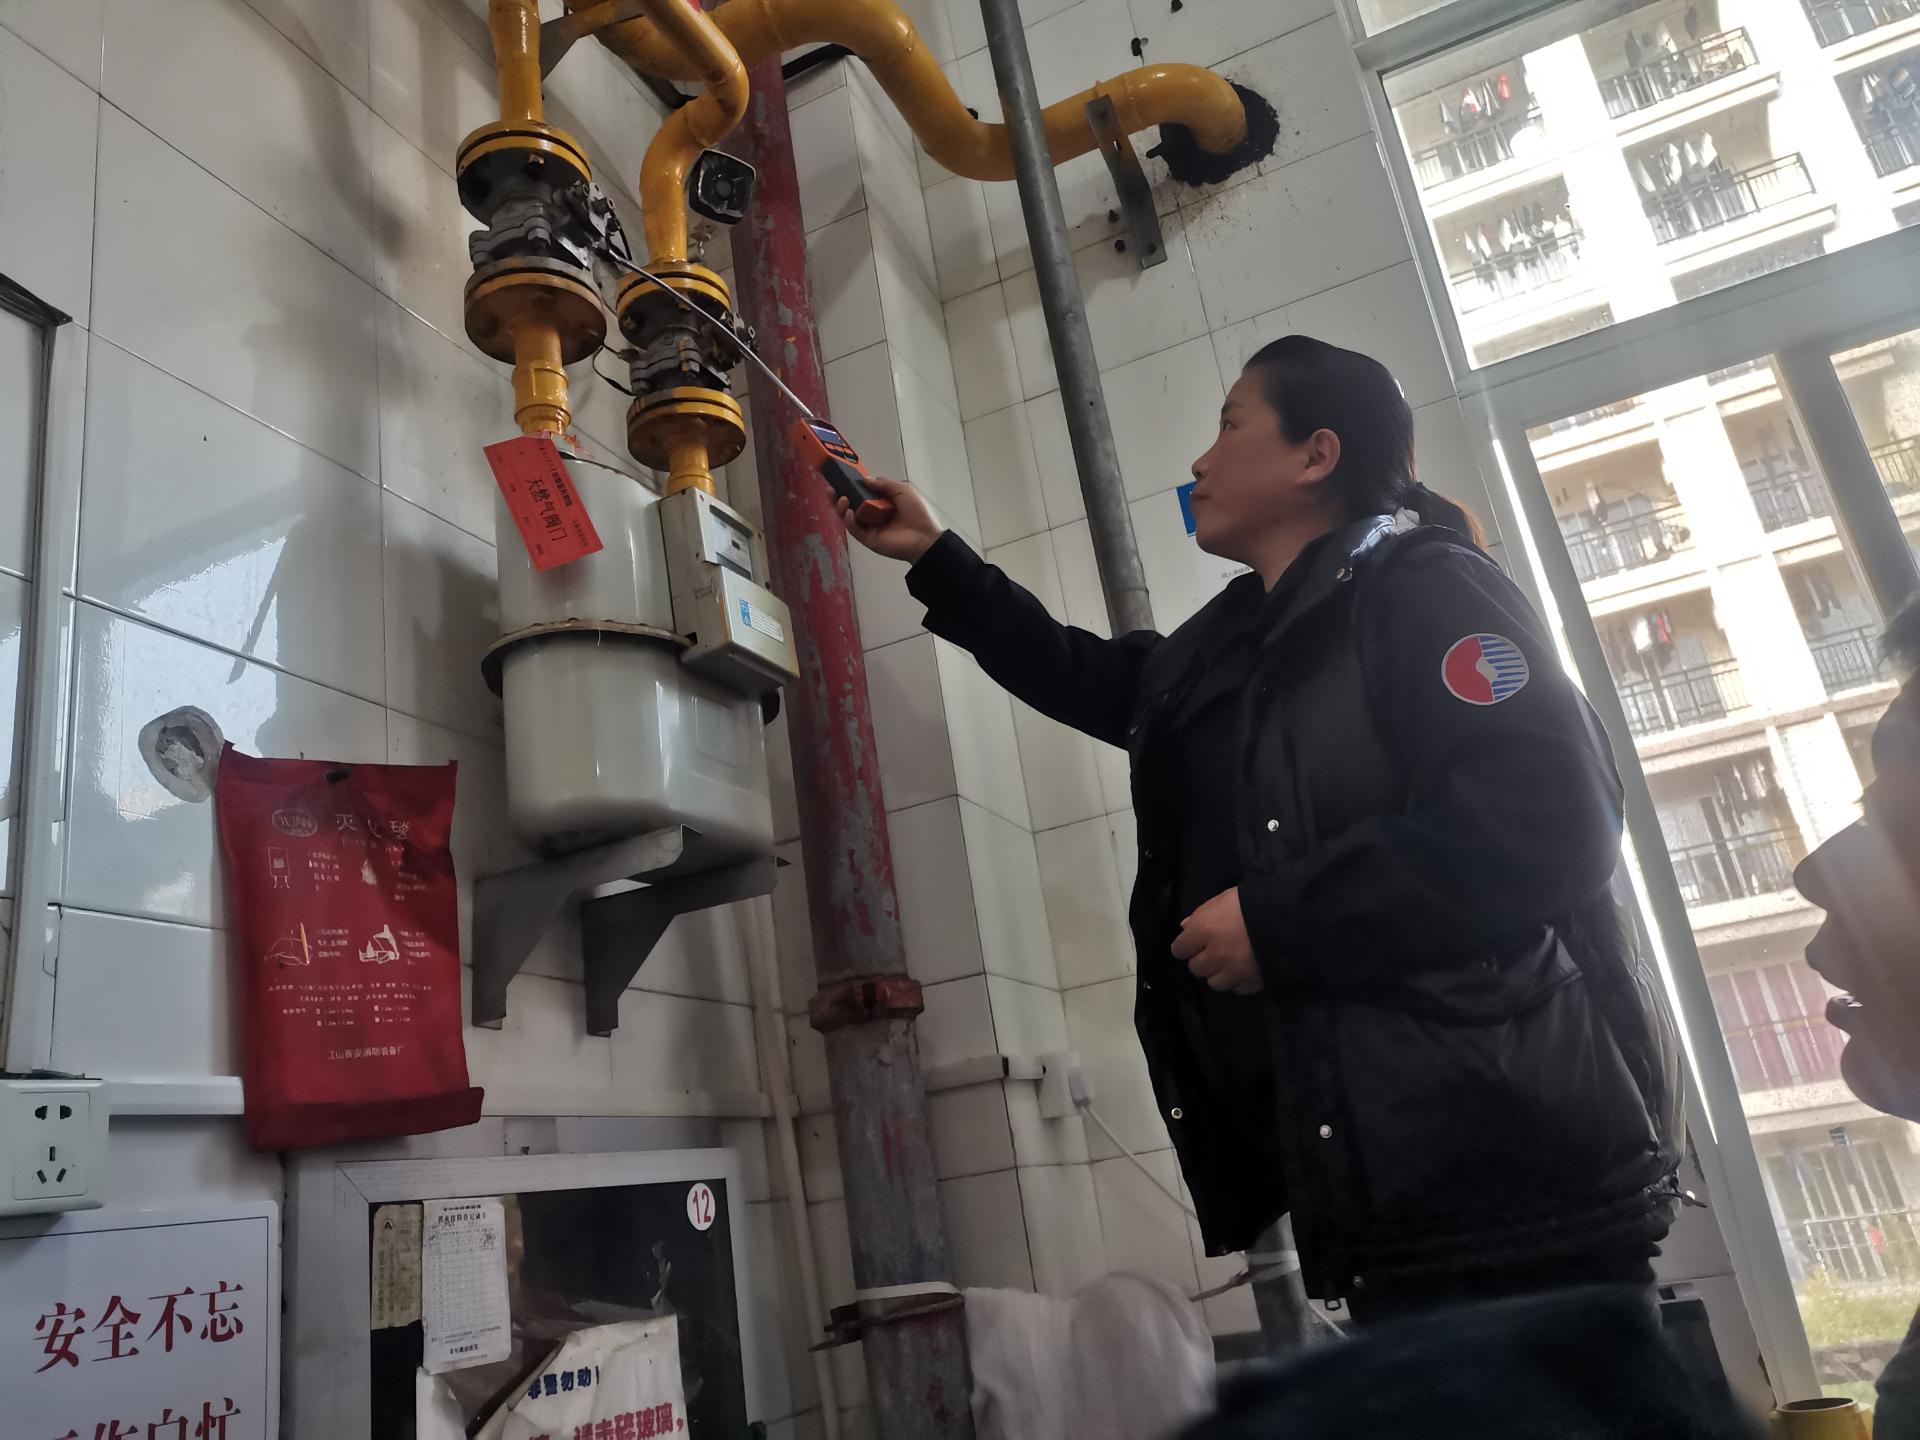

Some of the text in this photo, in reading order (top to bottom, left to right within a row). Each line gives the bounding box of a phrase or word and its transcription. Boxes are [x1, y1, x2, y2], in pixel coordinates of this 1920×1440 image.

[526, 477, 568, 542] 天然气阀门
[693, 1189, 711, 1224] 12
[34, 1280, 244, 1374] 安全不忘
